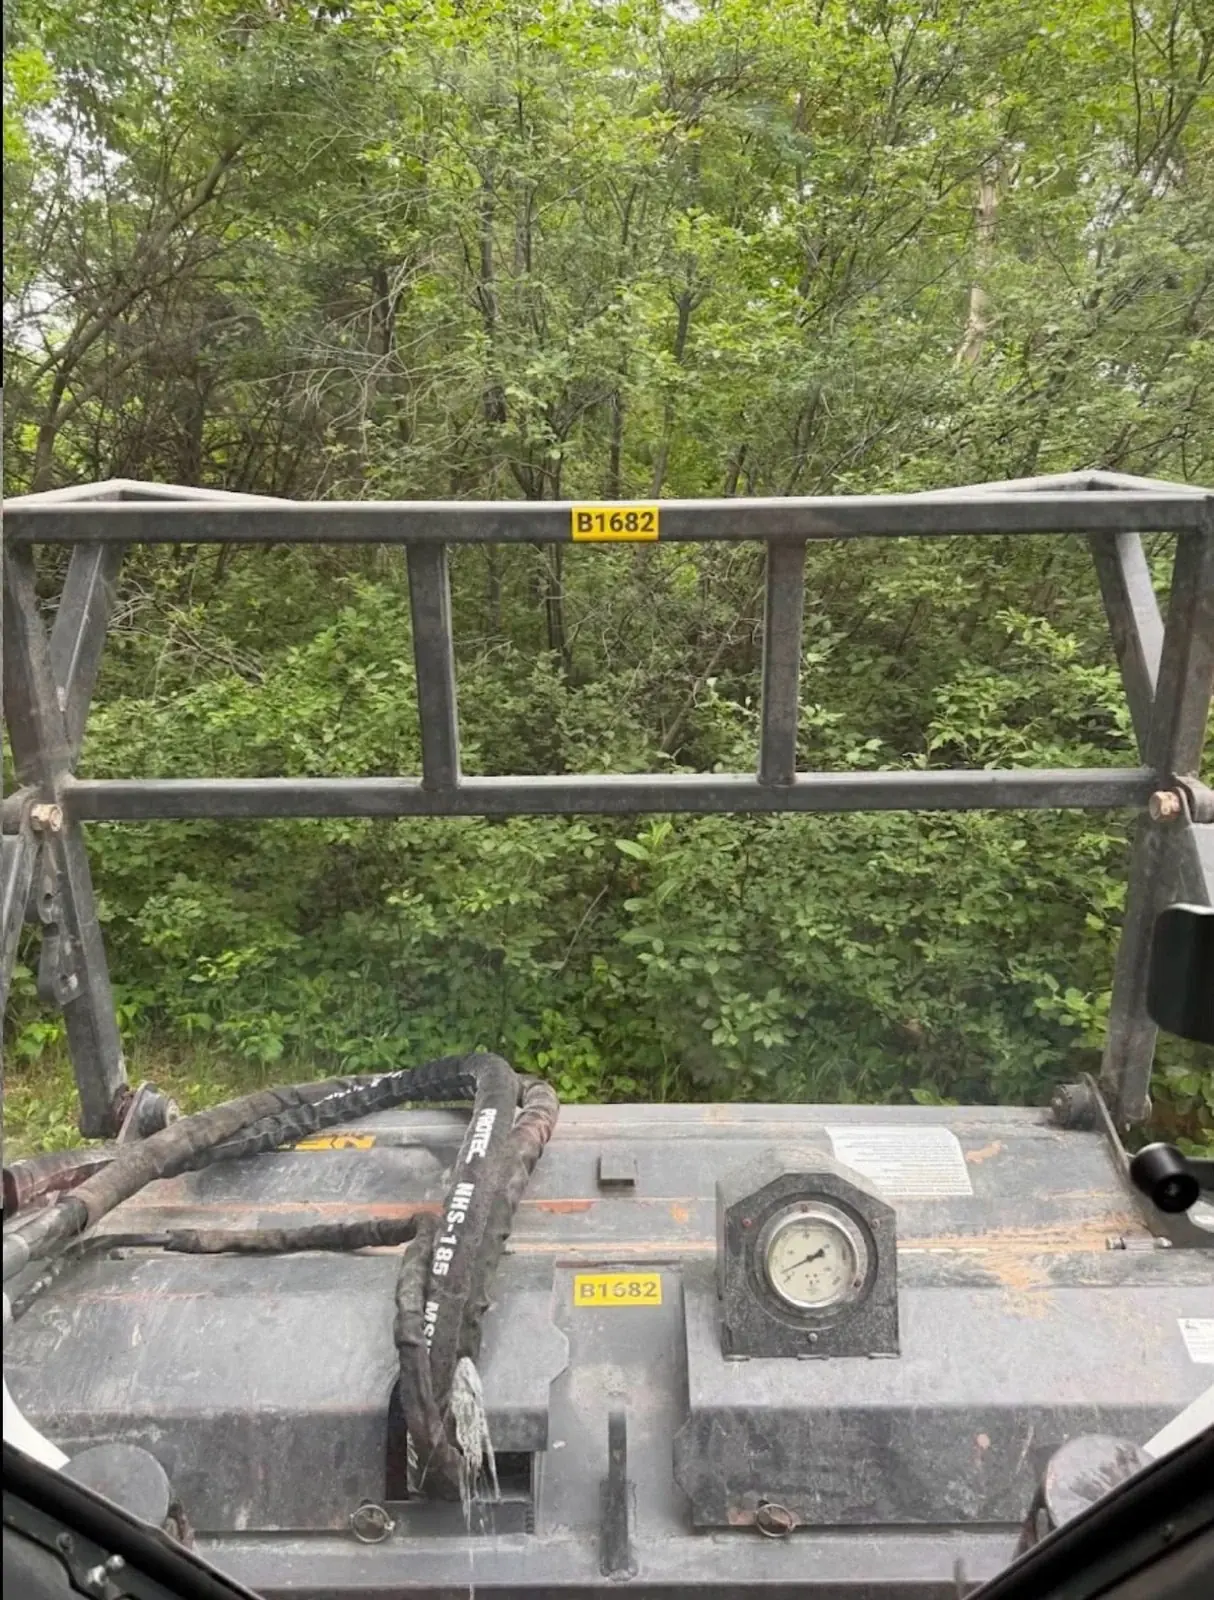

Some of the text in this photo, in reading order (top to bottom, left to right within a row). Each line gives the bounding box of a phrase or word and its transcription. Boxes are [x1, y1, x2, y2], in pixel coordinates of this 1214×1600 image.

[577, 512, 654, 532] B1682
[424, 1108, 498, 1355] PROTEC NHS-185 MS
[580, 1281, 658, 1298] B1682
